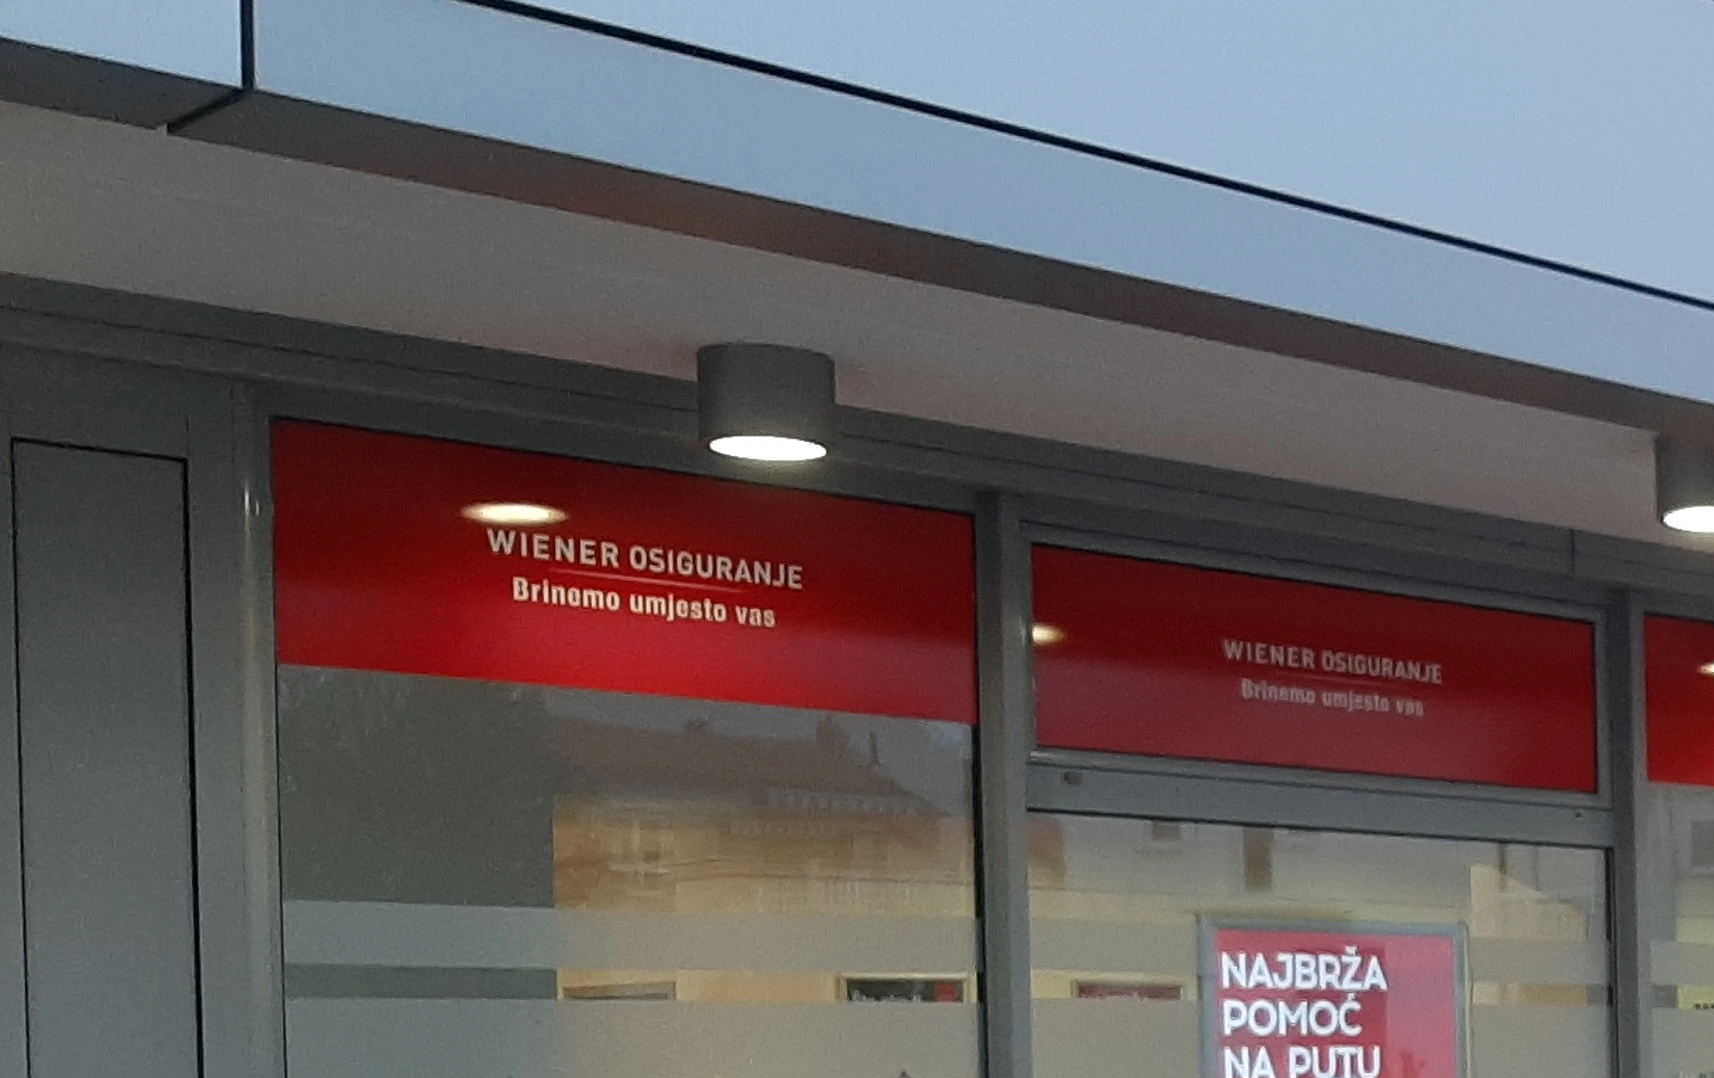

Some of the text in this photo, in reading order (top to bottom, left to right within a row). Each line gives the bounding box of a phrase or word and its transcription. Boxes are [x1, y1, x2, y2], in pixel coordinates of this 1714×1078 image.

[486, 527, 803, 590] WIENER OSIGURANJE
[512, 576, 776, 628] Brinemo umjesto vas
[1223, 639, 1443, 684] WIENER OSIGURANJE
[1221, 945, 1388, 991] NAJBRŽA
[1223, 992, 1362, 1037] POMOĆ
